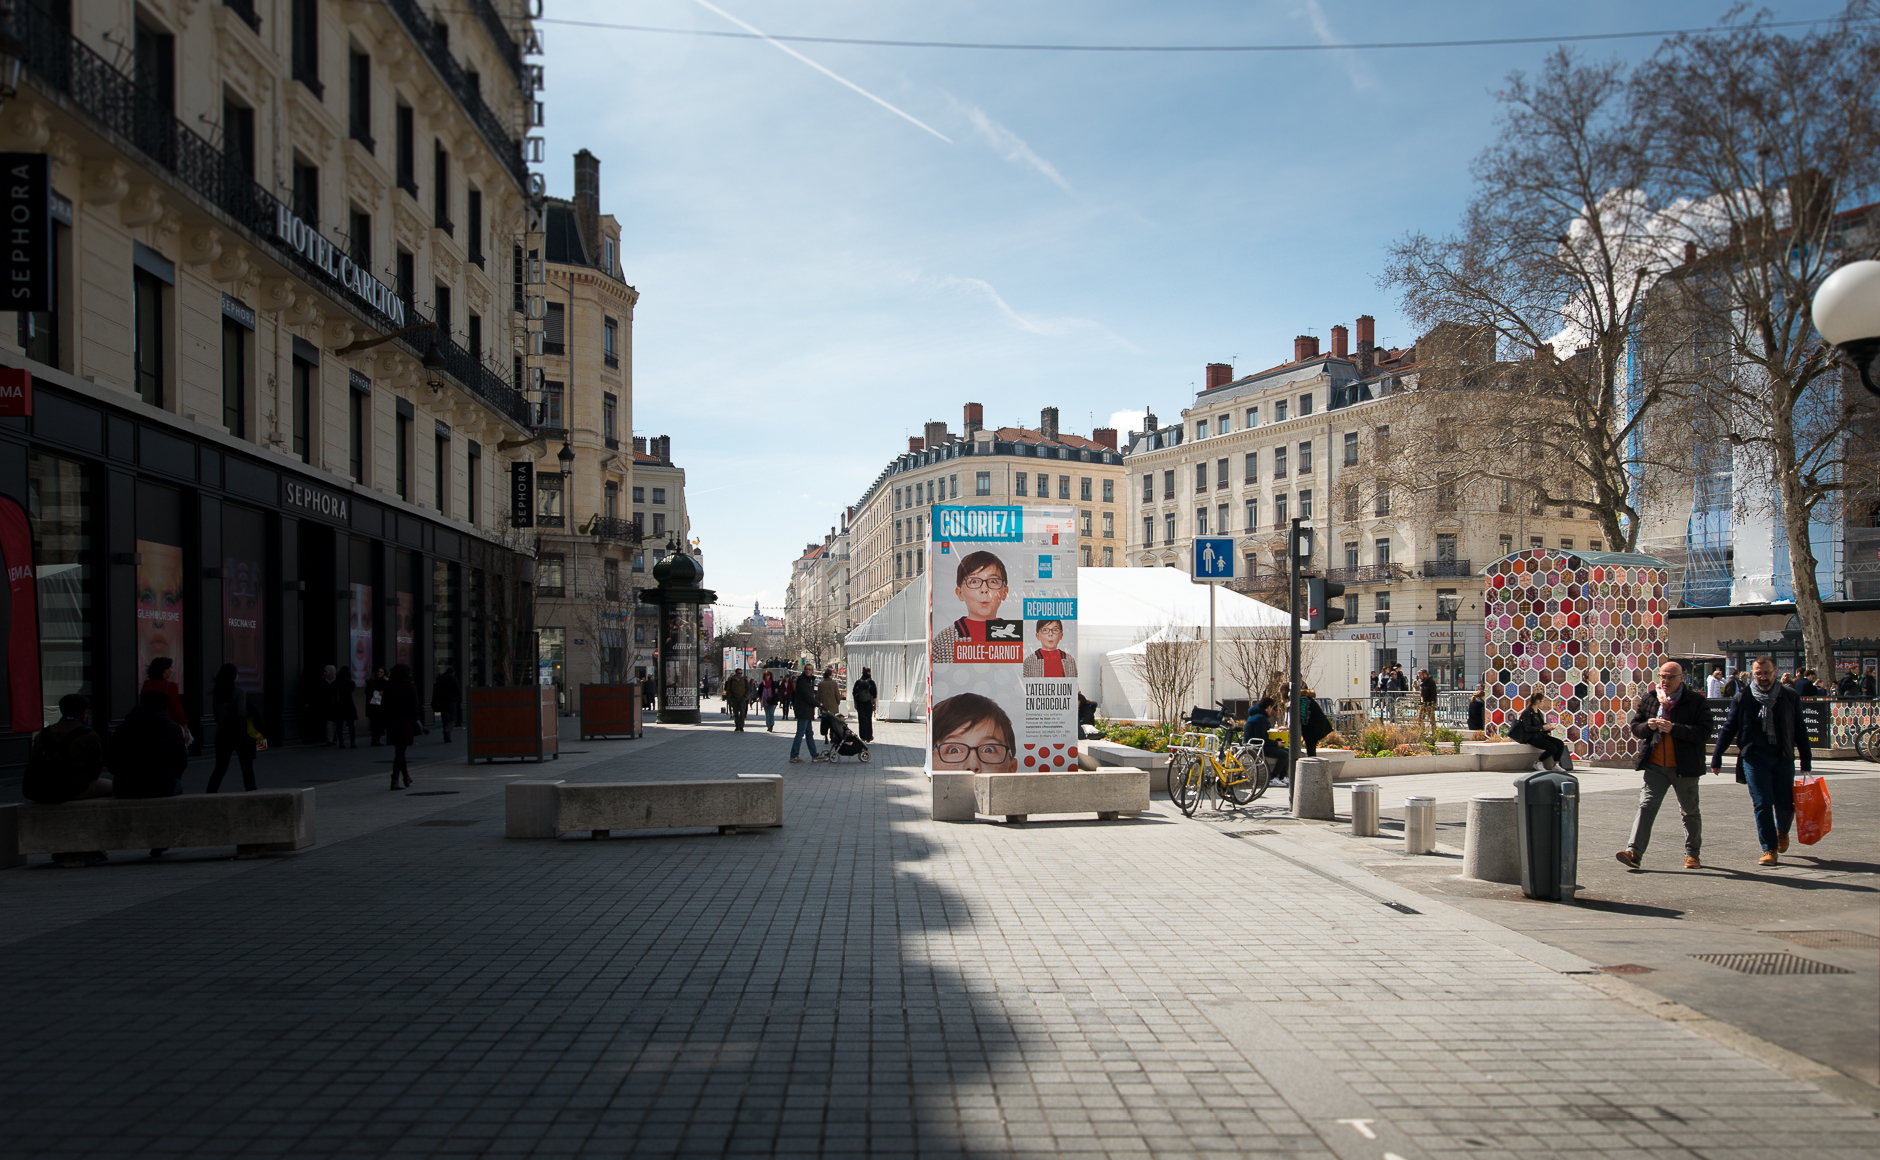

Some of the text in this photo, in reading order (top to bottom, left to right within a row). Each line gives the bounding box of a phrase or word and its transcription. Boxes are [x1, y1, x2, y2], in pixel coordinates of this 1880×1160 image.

[10, 164, 31, 299] SEPHORA
[276, 203, 405, 329] HOTEL CARLTON
[221, 297, 255, 326] SEPHORA
[285, 481, 348, 521] SEPHORA
[517, 466, 527, 524] SEPHORA
[1027, 601, 1074, 618] RÉPUBLIQUE
[956, 643, 1021, 661] GROLÉE-CARNOT
[1025, 683, 1073, 696] L'ATELIER LION
[1025, 697, 1071, 710] EN CHOCOLAT
